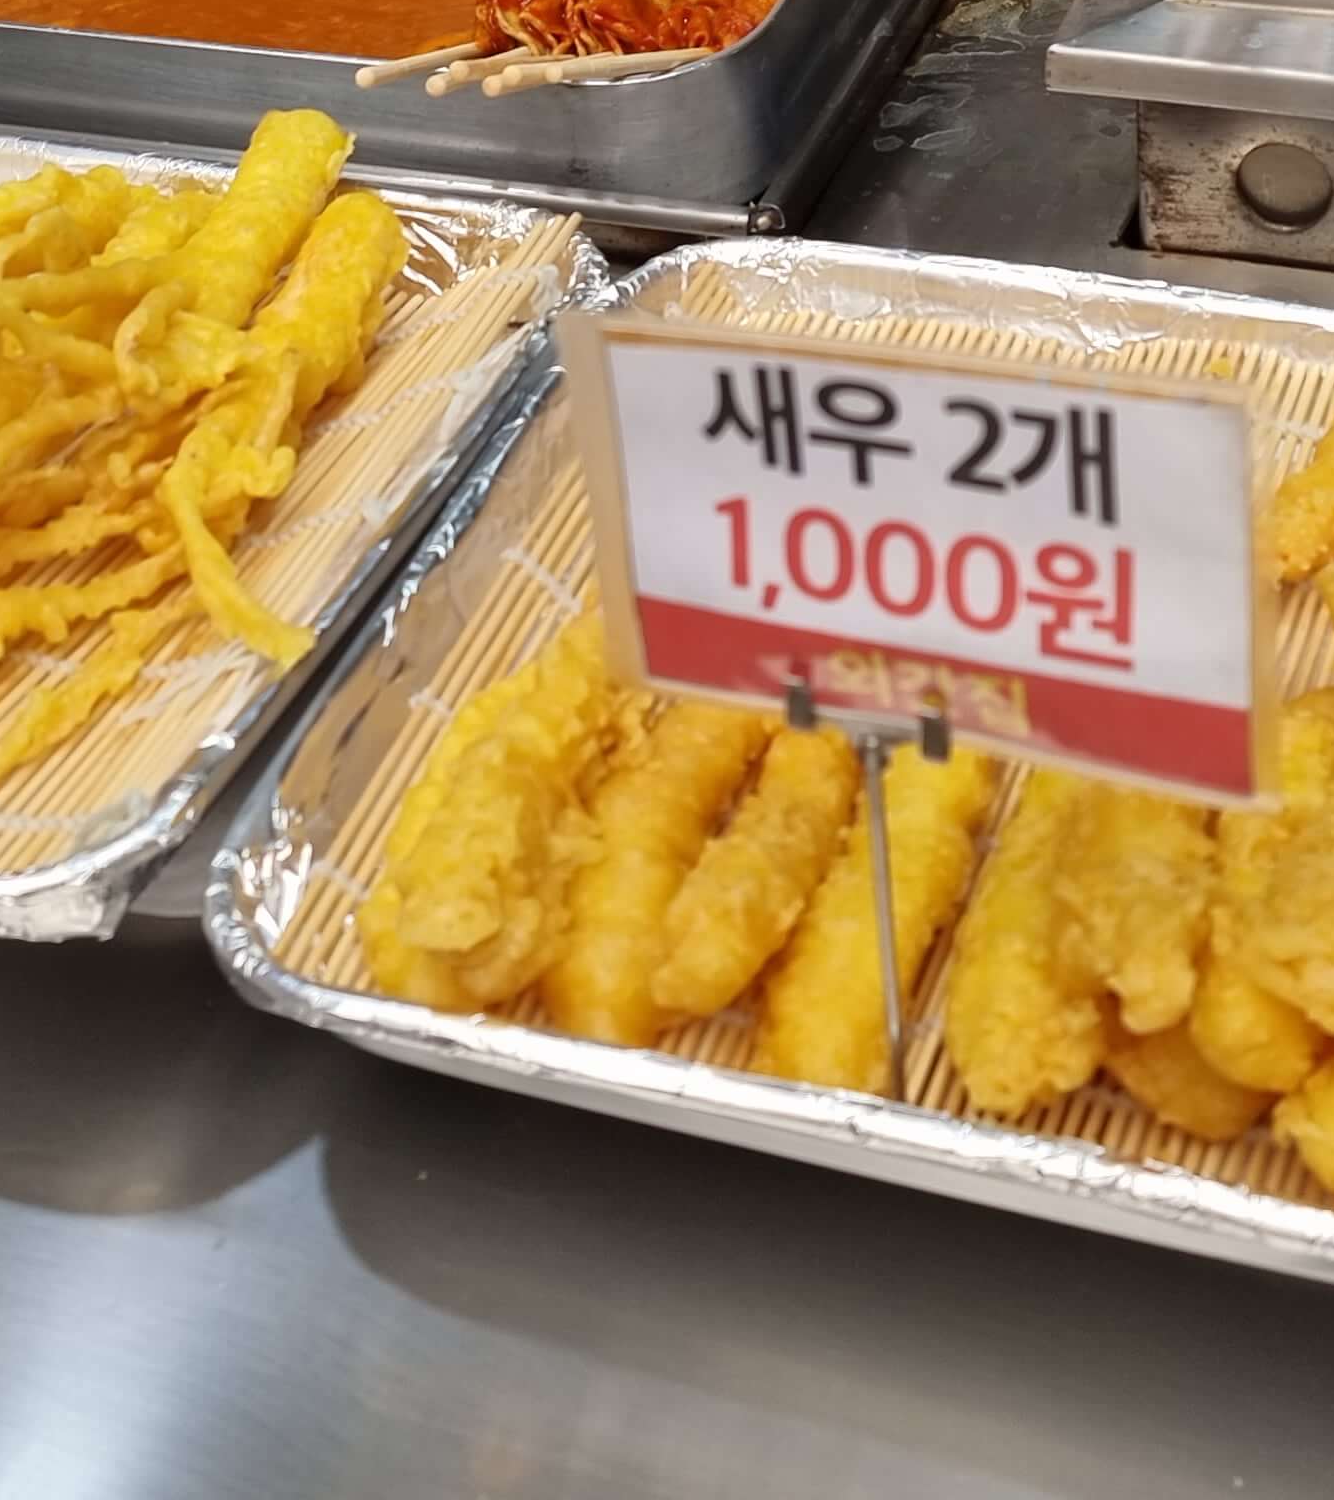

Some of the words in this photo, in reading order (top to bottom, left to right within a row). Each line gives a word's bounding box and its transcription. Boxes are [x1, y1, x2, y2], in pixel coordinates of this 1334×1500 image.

[701, 362, 914, 489] 새우
[942, 395, 1120, 527] 2개
[712, 496, 1138, 673] 1,000원
